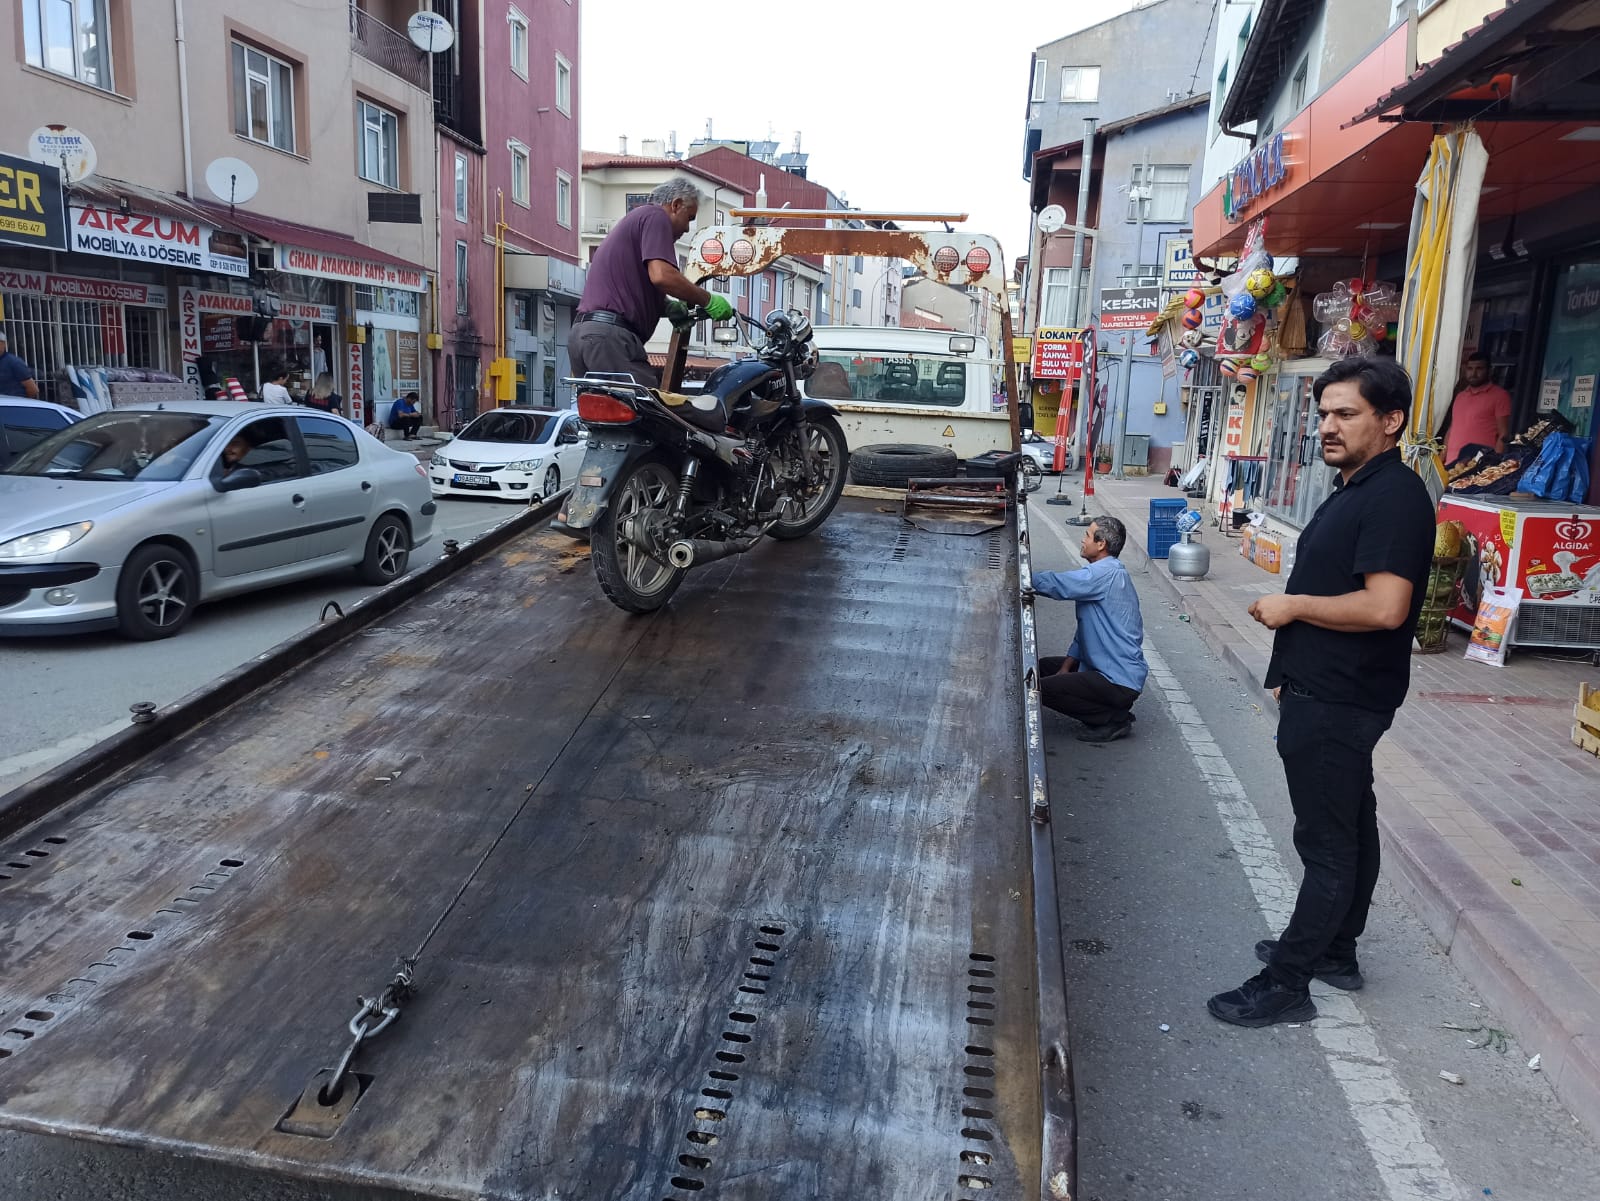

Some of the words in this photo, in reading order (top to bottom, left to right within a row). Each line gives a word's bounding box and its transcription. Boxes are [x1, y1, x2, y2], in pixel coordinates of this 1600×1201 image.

[77, 204, 200, 247] ARZUM
[77, 233, 139, 256] MOBİLYA
[140, 245, 147, 256] &
[149, 245, 202, 267] DÖŞEME
[289, 250, 318, 271] CİHAN
[320, 256, 363, 277] AYAKKABI
[365, 264, 385, 284] SATIŞ
[51, 280, 95, 295] MOBİLYA
[103, 285, 143, 300] DÖŞEME
[199, 294, 253, 312] AYAKKAB
[299, 304, 321, 318] USTA
